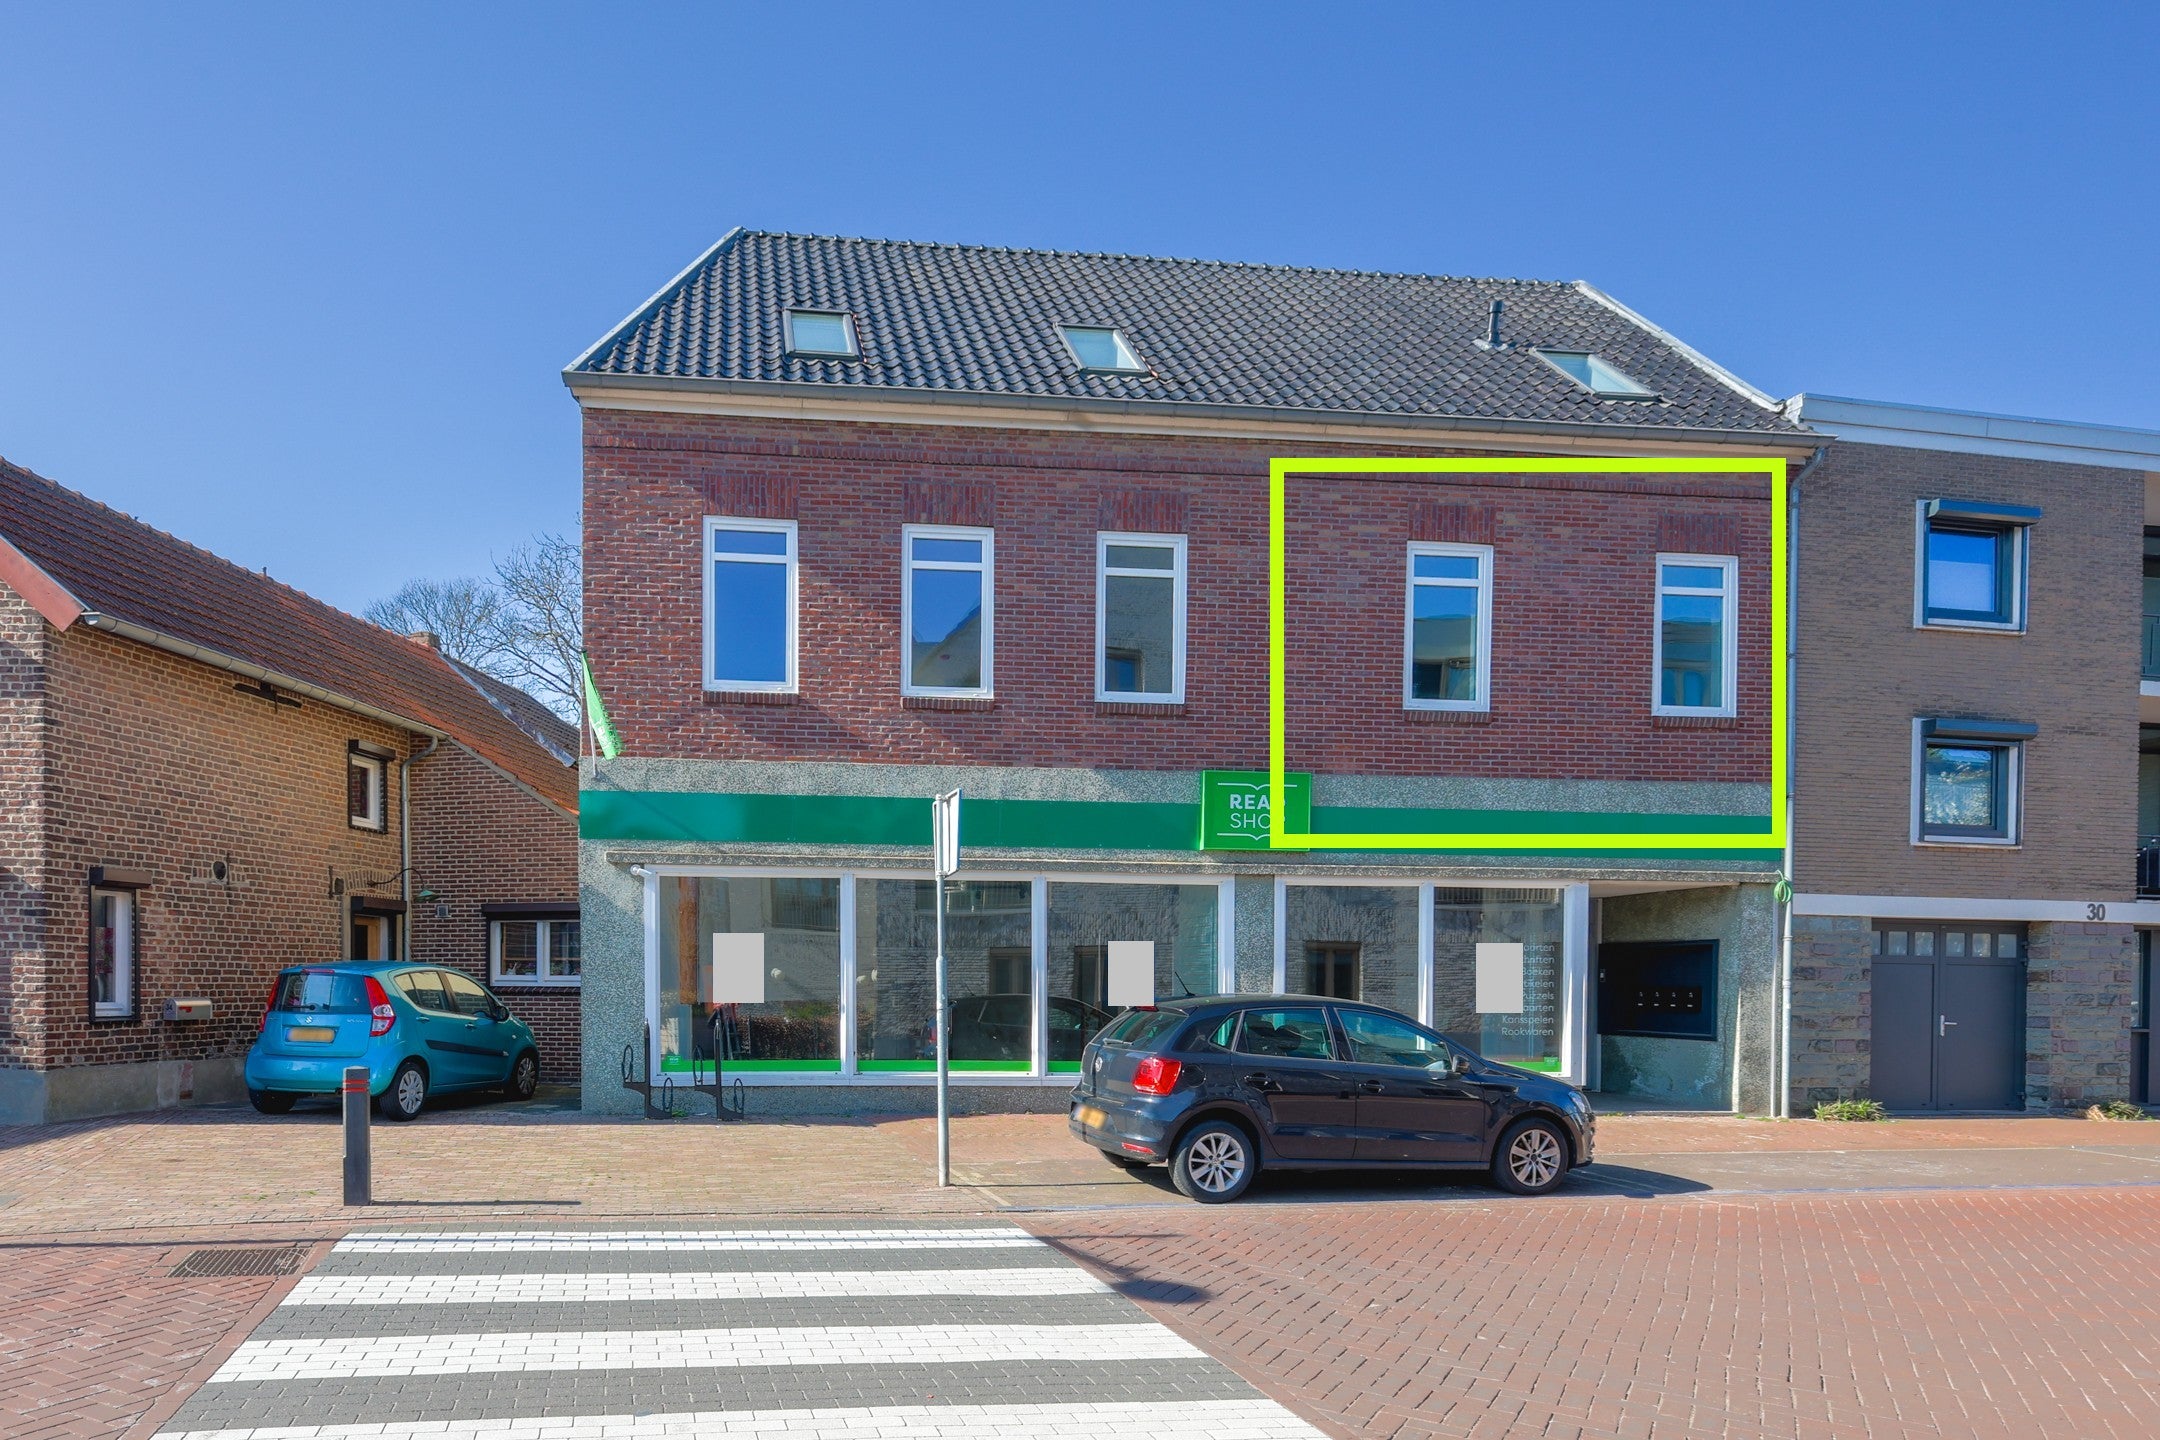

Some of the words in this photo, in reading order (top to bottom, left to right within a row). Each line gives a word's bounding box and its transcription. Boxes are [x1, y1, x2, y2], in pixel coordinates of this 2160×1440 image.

[1229, 794, 1285, 810] REA
[1230, 812, 1285, 829] SHO
[2086, 903, 2106, 921] 30
[1523, 944, 1555, 952] aarten
[1523, 979, 1555, 988] tikelen
[1523, 1004, 1555, 1012] aarten
[1502, 1015, 1554, 1026] Kansspelen
[1501, 1027, 1554, 1036] Rookwaren
